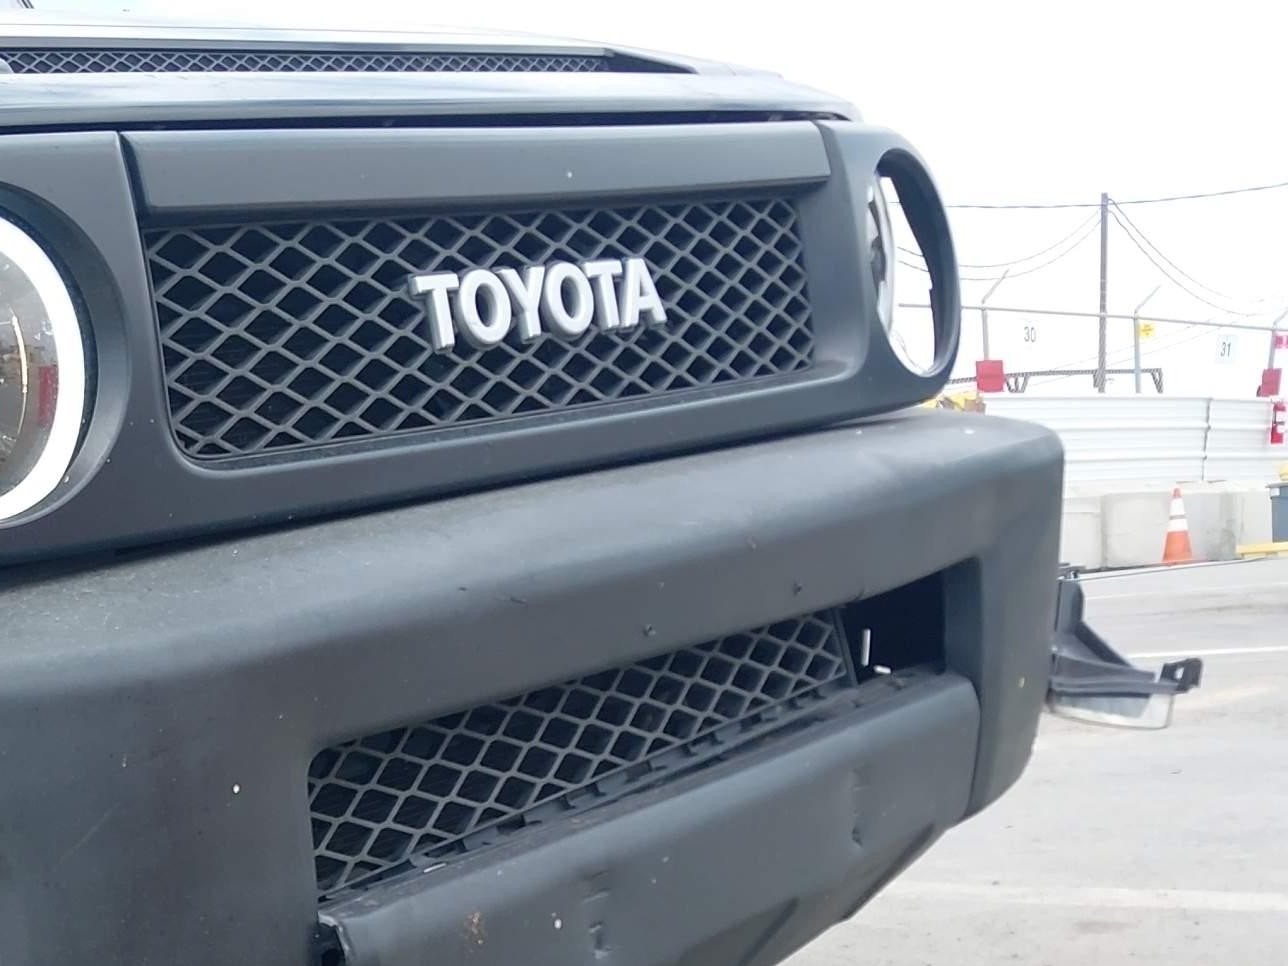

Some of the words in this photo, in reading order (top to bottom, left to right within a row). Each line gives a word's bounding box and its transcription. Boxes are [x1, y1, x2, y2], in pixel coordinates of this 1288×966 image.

[411, 257, 668, 352] TOYOTA
[1024, 326, 1037, 343] 30
[1220, 341, 1232, 358] 31
